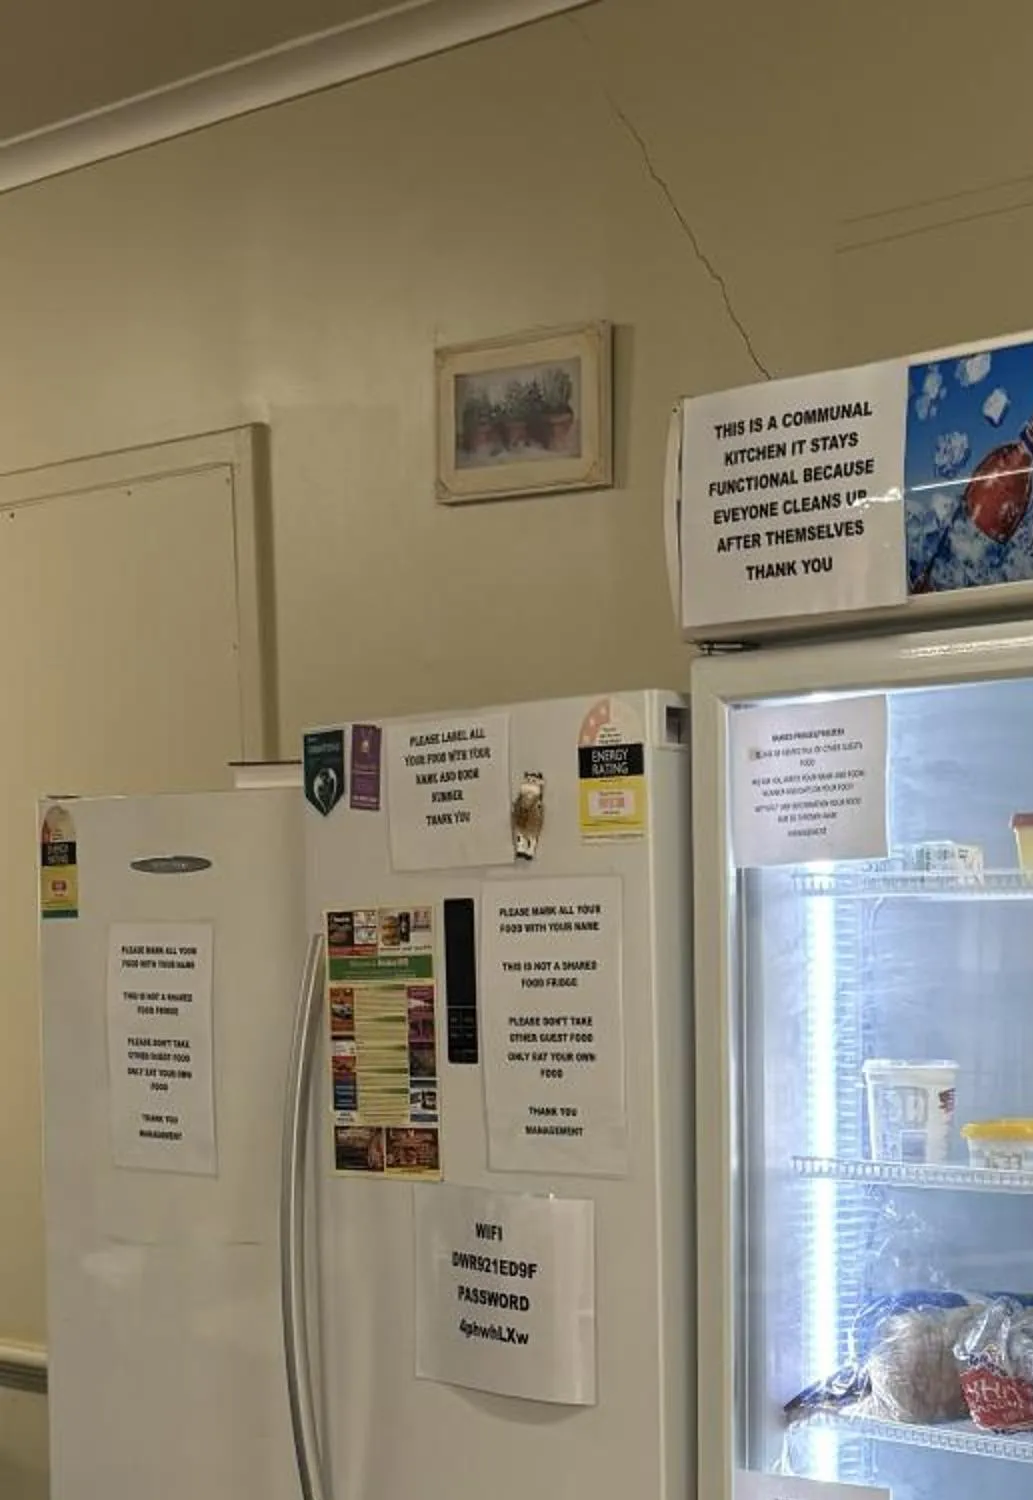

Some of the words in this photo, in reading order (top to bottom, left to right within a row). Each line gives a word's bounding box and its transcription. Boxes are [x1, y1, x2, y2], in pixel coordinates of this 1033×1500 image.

[715, 420, 745, 440] THIS
[749, 418, 763, 433] IS
[767, 415, 778, 431] A
[782, 401, 873, 428] COMMUNAL
[724, 442, 787, 466] KITCHEN
[791, 439, 806, 456] IT
[811, 432, 859, 453] STAYS
[708, 469, 798, 497] FUNCTIONAL
[803, 458, 875, 483] BECAUSE
[713, 500, 779, 525] EVEYONE
[783, 492, 841, 515] CLEANS
[846, 489, 867, 506] UP
[716, 533, 761, 554] AFTER
[765, 519, 865, 547] THEMSELVES
[746, 562, 797, 581] THANK
[801, 556, 833, 573] YOU
[592, 749, 628, 762] ENERGY
[524, 923, 546, 933] WITH
[534, 961, 552, 971] NOT
[554, 961, 561, 970] A
[476, 1222, 503, 1242] WIFI
[458, 1285, 530, 1311] PASSWORD
